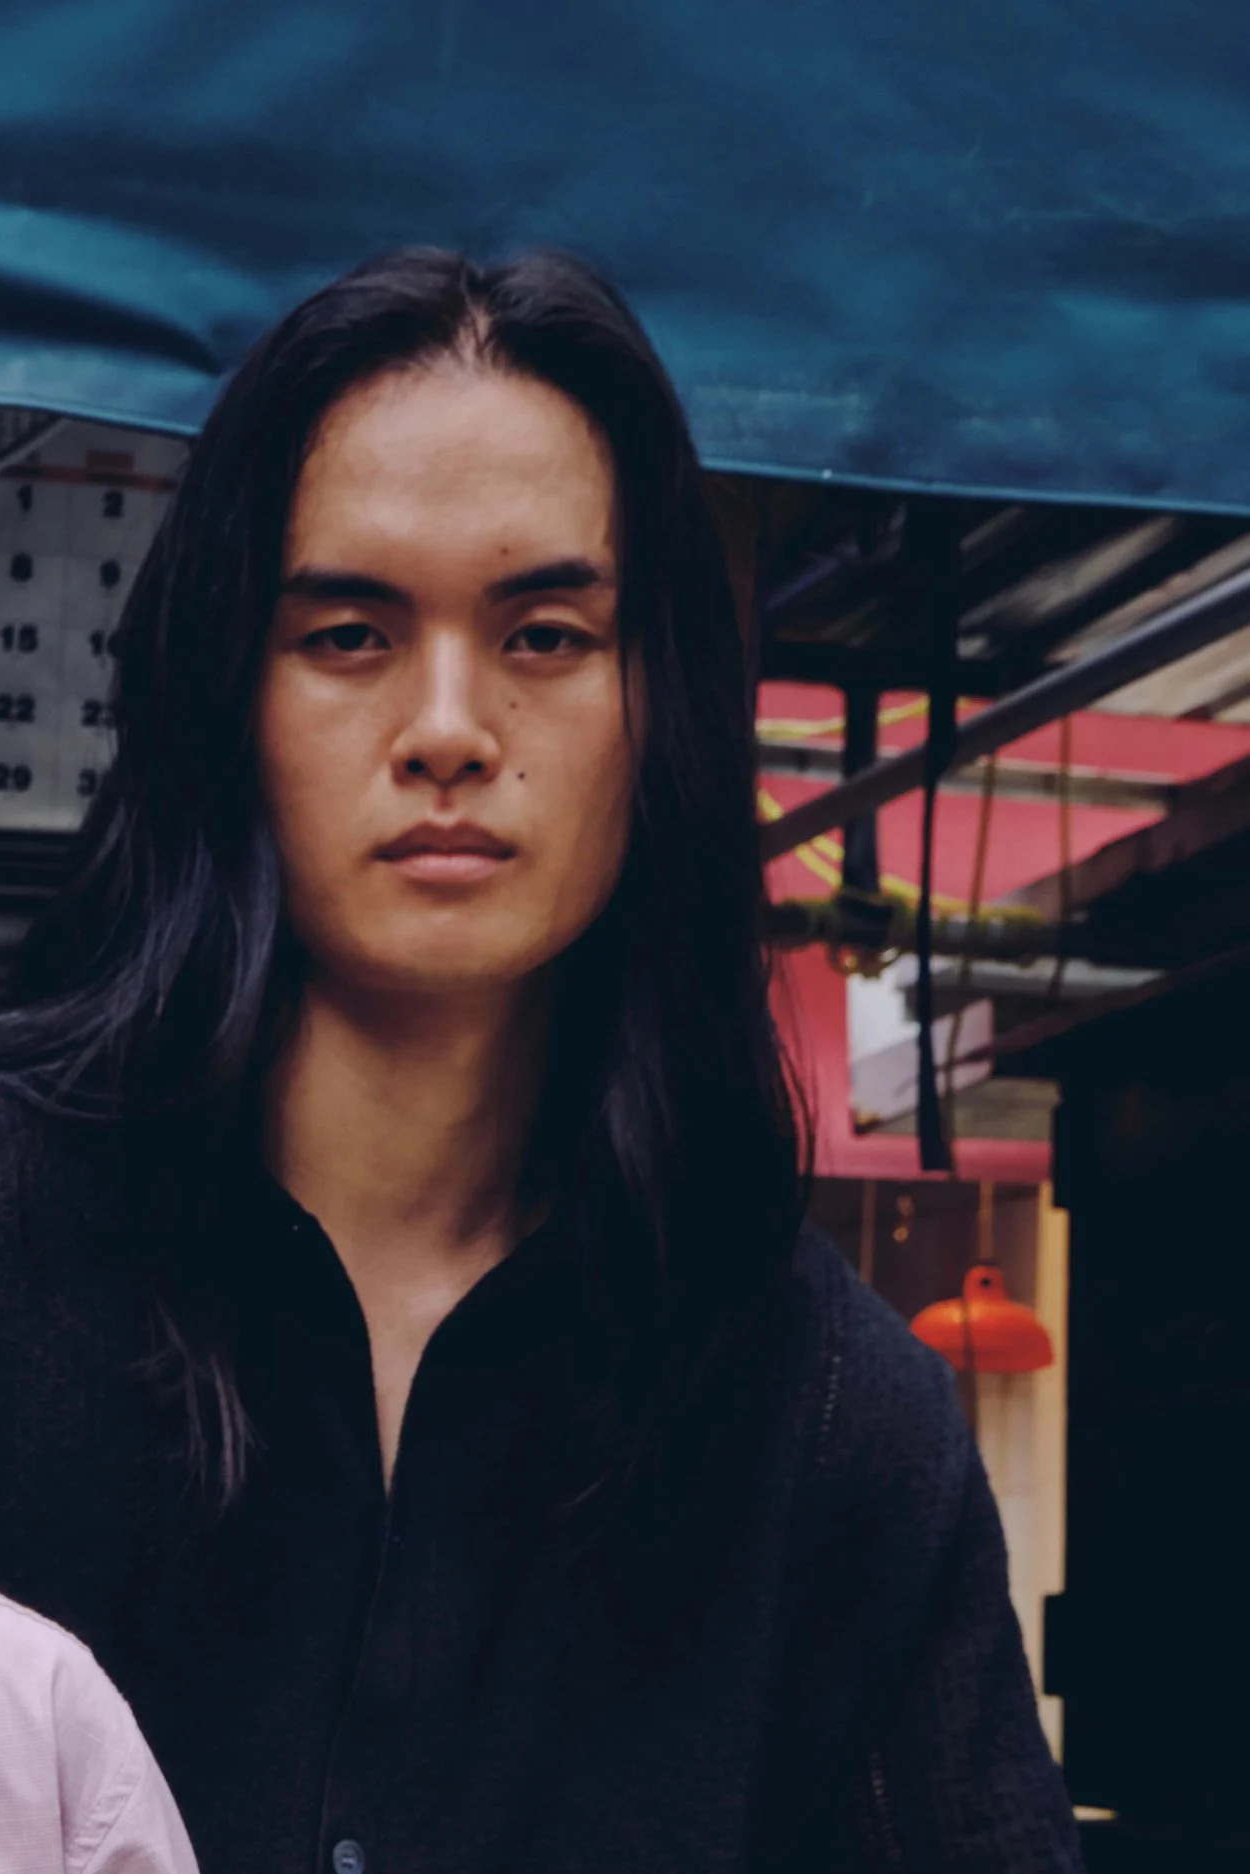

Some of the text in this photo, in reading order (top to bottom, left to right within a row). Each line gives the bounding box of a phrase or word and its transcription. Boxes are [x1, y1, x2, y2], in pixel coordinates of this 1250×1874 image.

[17, 484, 124, 519] 1 2
[10, 552, 33, 582] 8
[0, 623, 39, 653] 15
[89, 629, 105, 657] 1
